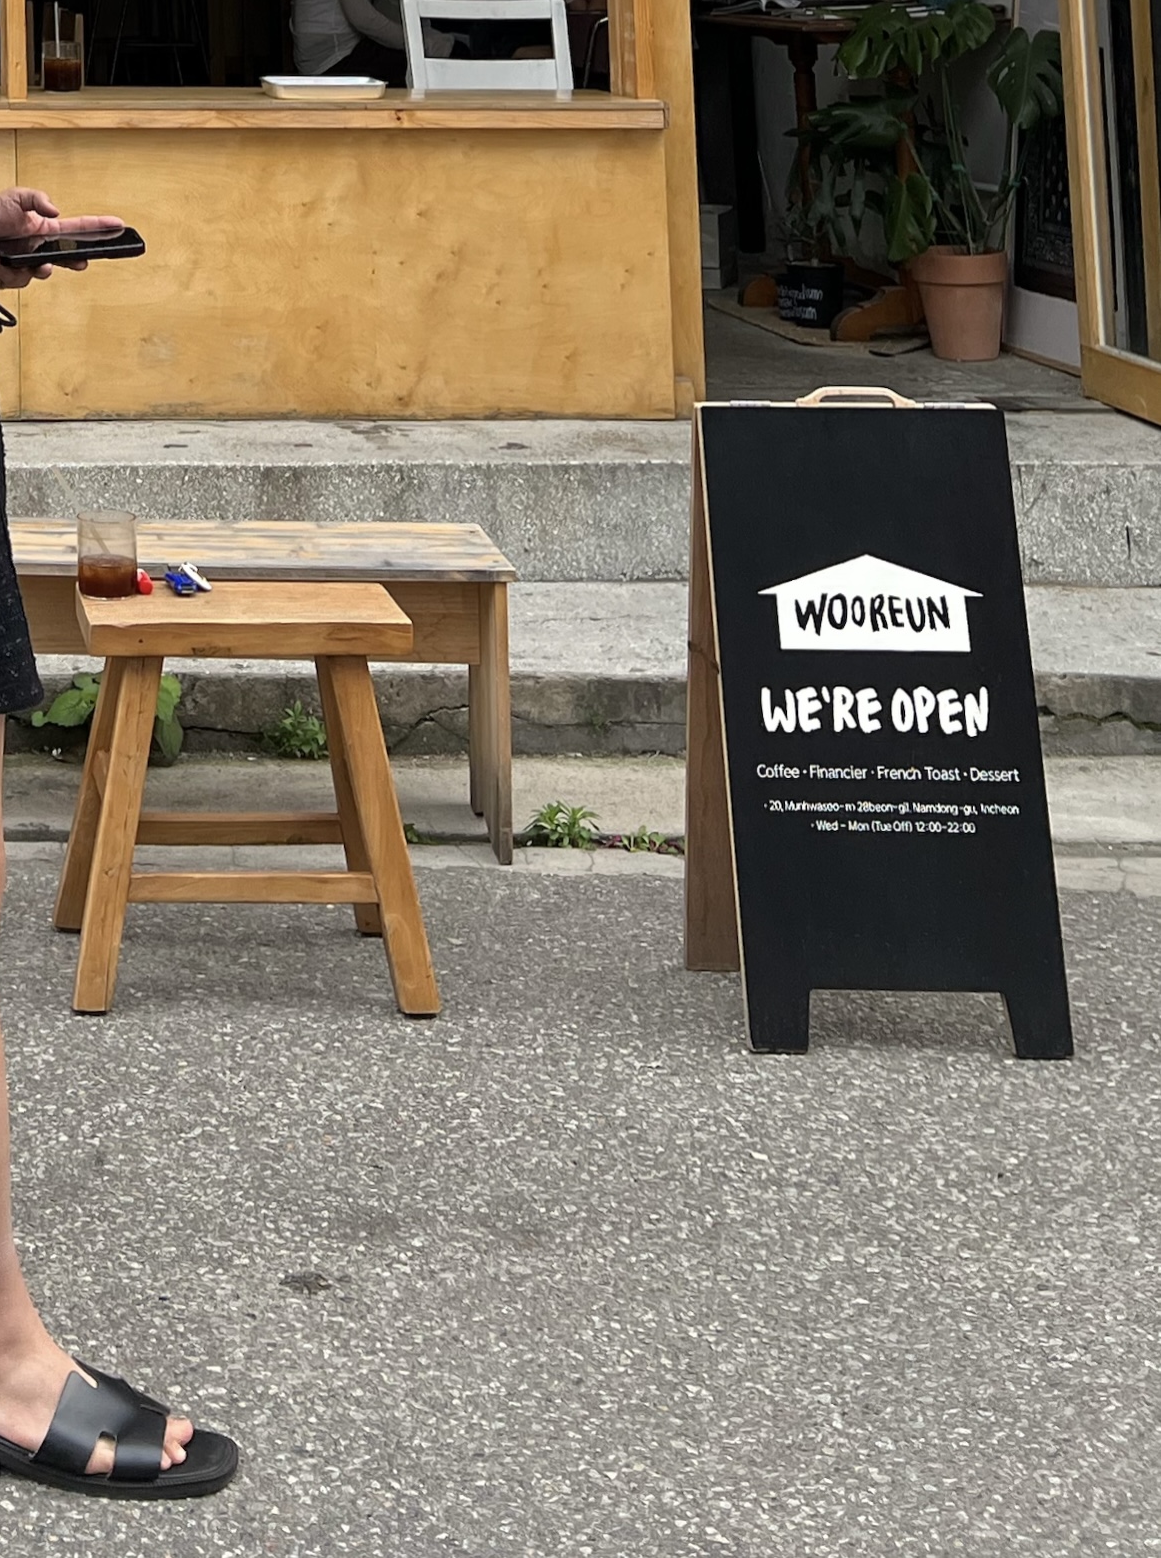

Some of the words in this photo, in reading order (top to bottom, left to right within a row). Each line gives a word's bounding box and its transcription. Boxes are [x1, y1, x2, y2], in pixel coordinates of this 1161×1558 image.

[794, 593, 951, 636] WOOREUN
[760, 686, 883, 734] WE'RE
[891, 686, 989, 738] OPEN
[756, 763, 800, 779] Coffee
[809, 764, 868, 780] Financier
[877, 765, 922, 780] French
[923, 765, 961, 781] Toast
[969, 766, 1020, 782] Dessert
[980, 803, 1020, 815] Incheon
[815, 820, 839, 831] Wed
[848, 820, 870, 832] Mon
[871, 820, 892, 833] (Tue
[893, 820, 913, 833] Off)
